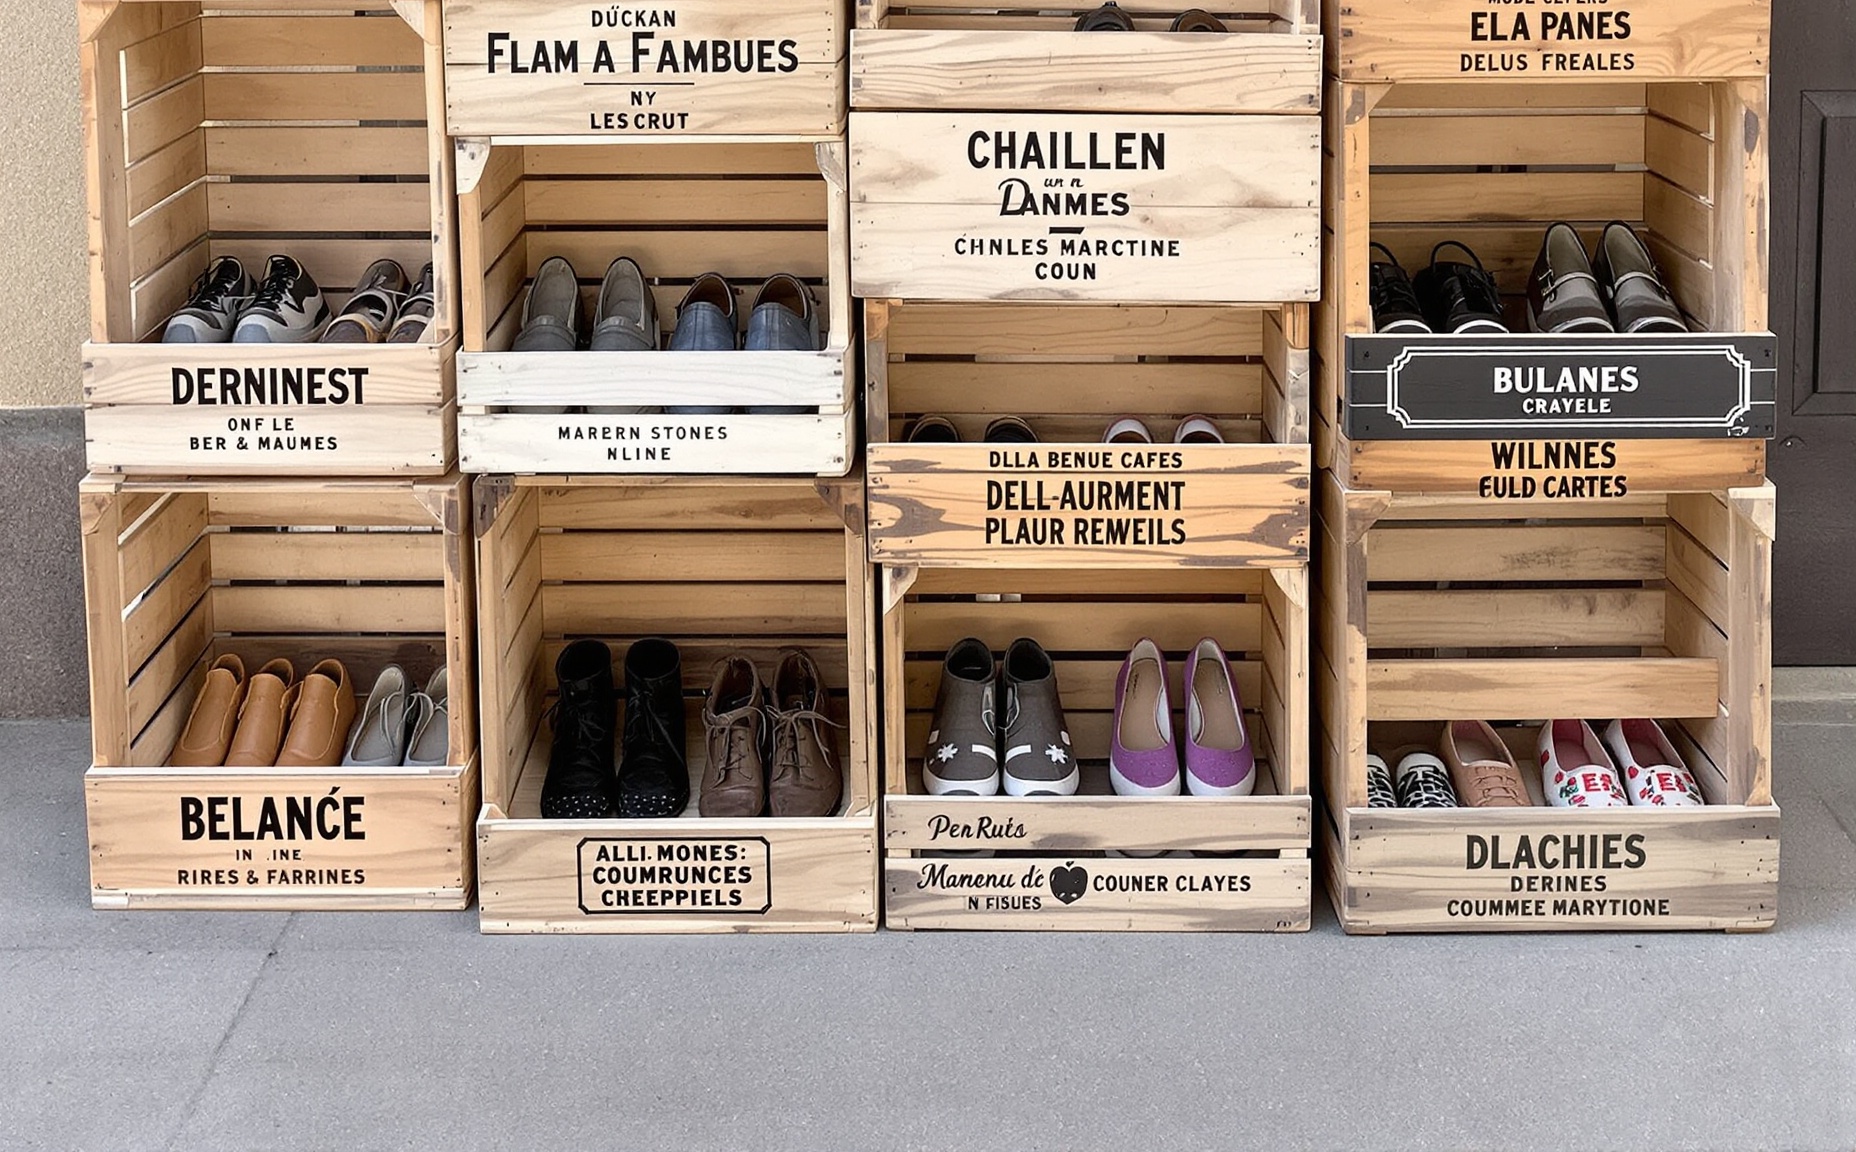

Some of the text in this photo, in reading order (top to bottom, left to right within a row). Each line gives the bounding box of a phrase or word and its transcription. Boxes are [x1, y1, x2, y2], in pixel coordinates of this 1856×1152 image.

[1472, 11, 1630, 41] ELA PANES
[488, 32, 798, 73] FLAM A FAMBUES
[1461, 53, 1634, 71] DELUS FREALES
[631, 91, 656, 105] NY
[591, 113, 688, 129] LES CRUT
[968, 131, 1164, 169] CHAILLEN
[1061, 240, 1179, 256] MARCTINE
[1035, 263, 1095, 280] COUN
[172, 368, 368, 405] DERNINEST
[1494, 366, 1638, 393] BULANES
[228, 418, 293, 431] ONF LE
[652, 427, 727, 439] STONES
[190, 437, 337, 450] BER & MAUMES
[608, 448, 670, 460] NLINE
[990, 451, 1182, 468] DLLA BENUE CAFES
[1492, 442, 1616, 469] WILNNES
[987, 480, 1185, 510] DELL-AURMENT
[1544, 476, 1627, 498] CARTES
[986, 518, 1064, 545] PLAUR
[1467, 834, 1646, 869] DLACHIES
[178, 869, 364, 884] RIRES & FARRINES
[593, 866, 751, 884] COUMRUNCES
[1094, 875, 1168, 892] COUNER
[1176, 876, 1250, 891] CLAYES
[1511, 876, 1606, 892] DERINES
[1448, 899, 1669, 916] COUMMEE MARYTIONE
